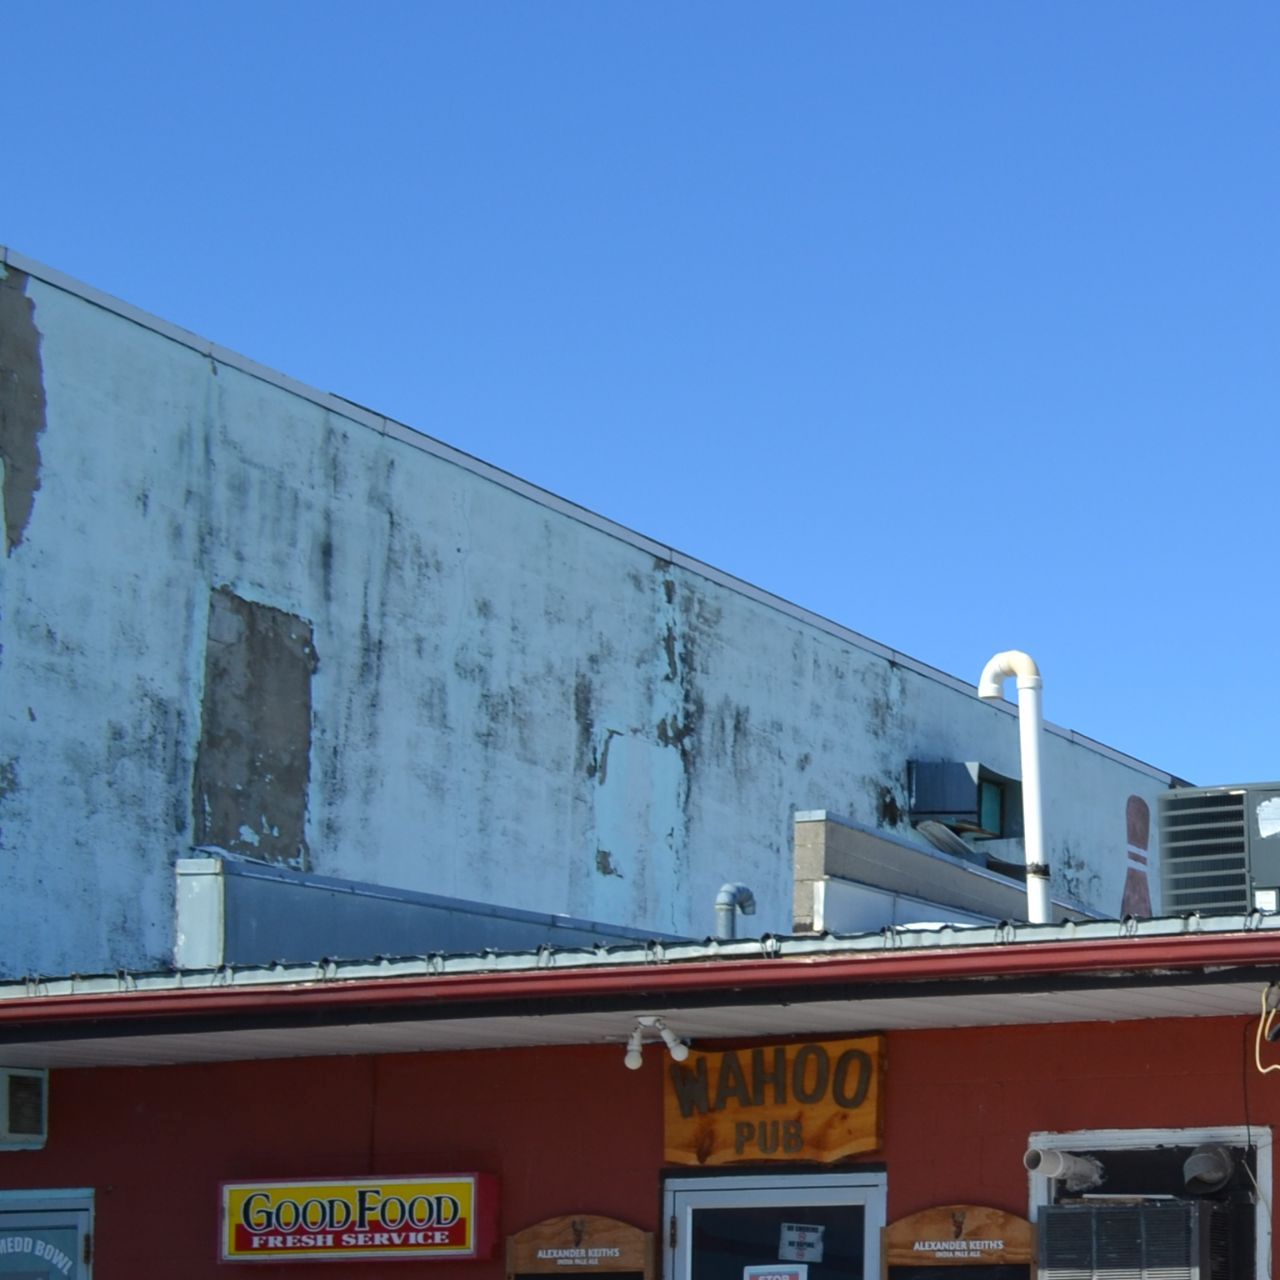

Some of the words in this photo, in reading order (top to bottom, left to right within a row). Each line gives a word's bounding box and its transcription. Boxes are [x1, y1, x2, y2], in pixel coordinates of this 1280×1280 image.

[671, 1044, 873, 1118] WAHOO
[735, 1119, 805, 1155] PUB
[252, 1232, 334, 1248] FRESH
[342, 1231, 450, 1246] SERVICE
[913, 1241, 967, 1251] ALEXANDER
[34, 1240, 73, 1275] BOWL
[537, 1249, 586, 1258] ALEXANDER
